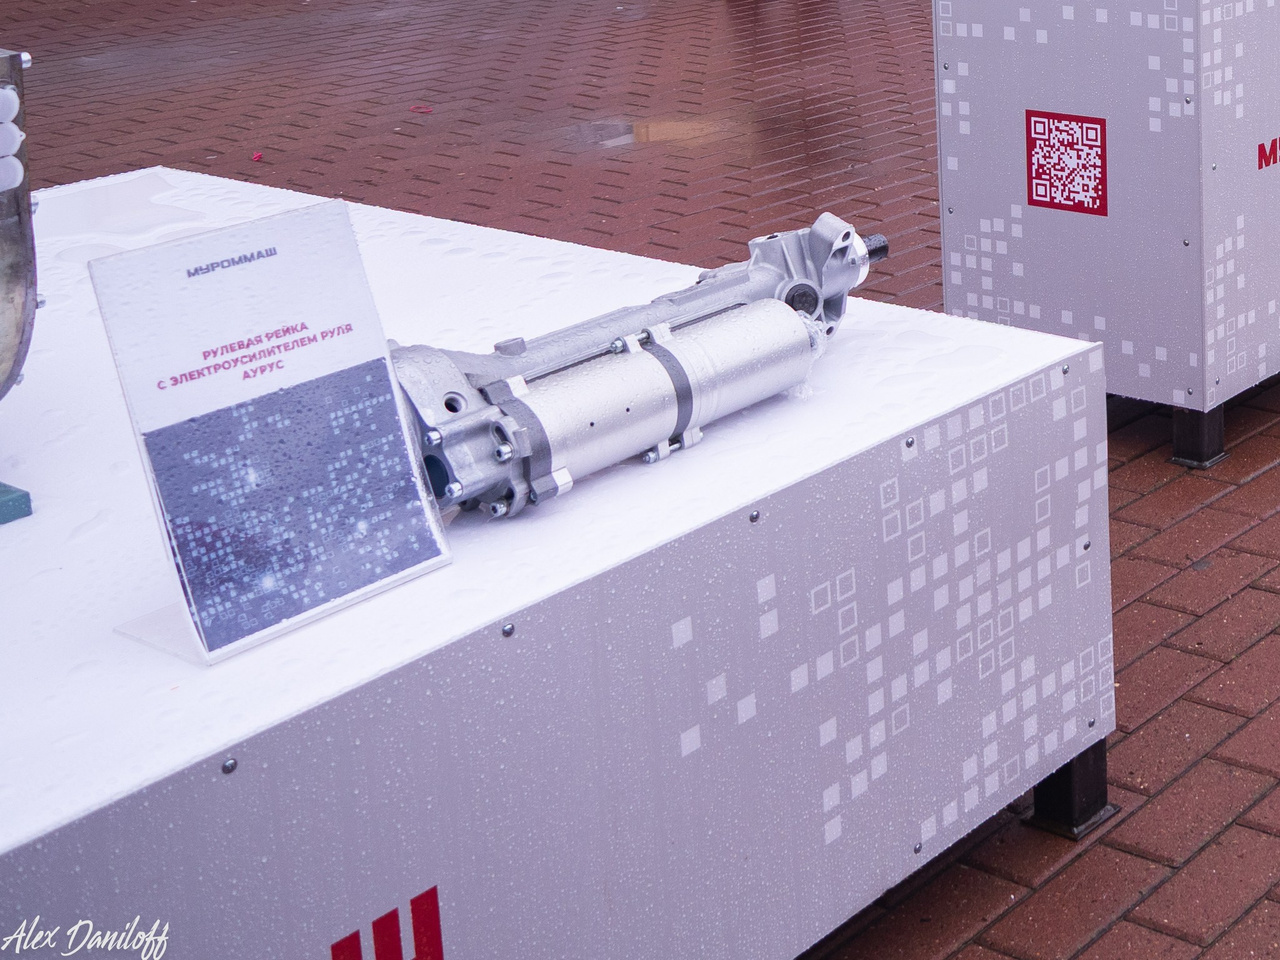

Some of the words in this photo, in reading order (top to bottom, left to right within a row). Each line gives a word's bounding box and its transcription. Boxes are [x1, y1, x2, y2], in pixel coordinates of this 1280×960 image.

[186, 246, 278, 278] МУРОММАШ
[157, 380, 167, 390] С
[170, 334, 318, 387] ЭЛЕКТРОУСИЛИТЕЛЕМ
[320, 323, 354, 341] РУЛЯ
[202, 334, 263, 361] РУЛЕВАЯ
[264, 321, 309, 342] РЕЙКА
[242, 359, 285, 381] АУРУС
